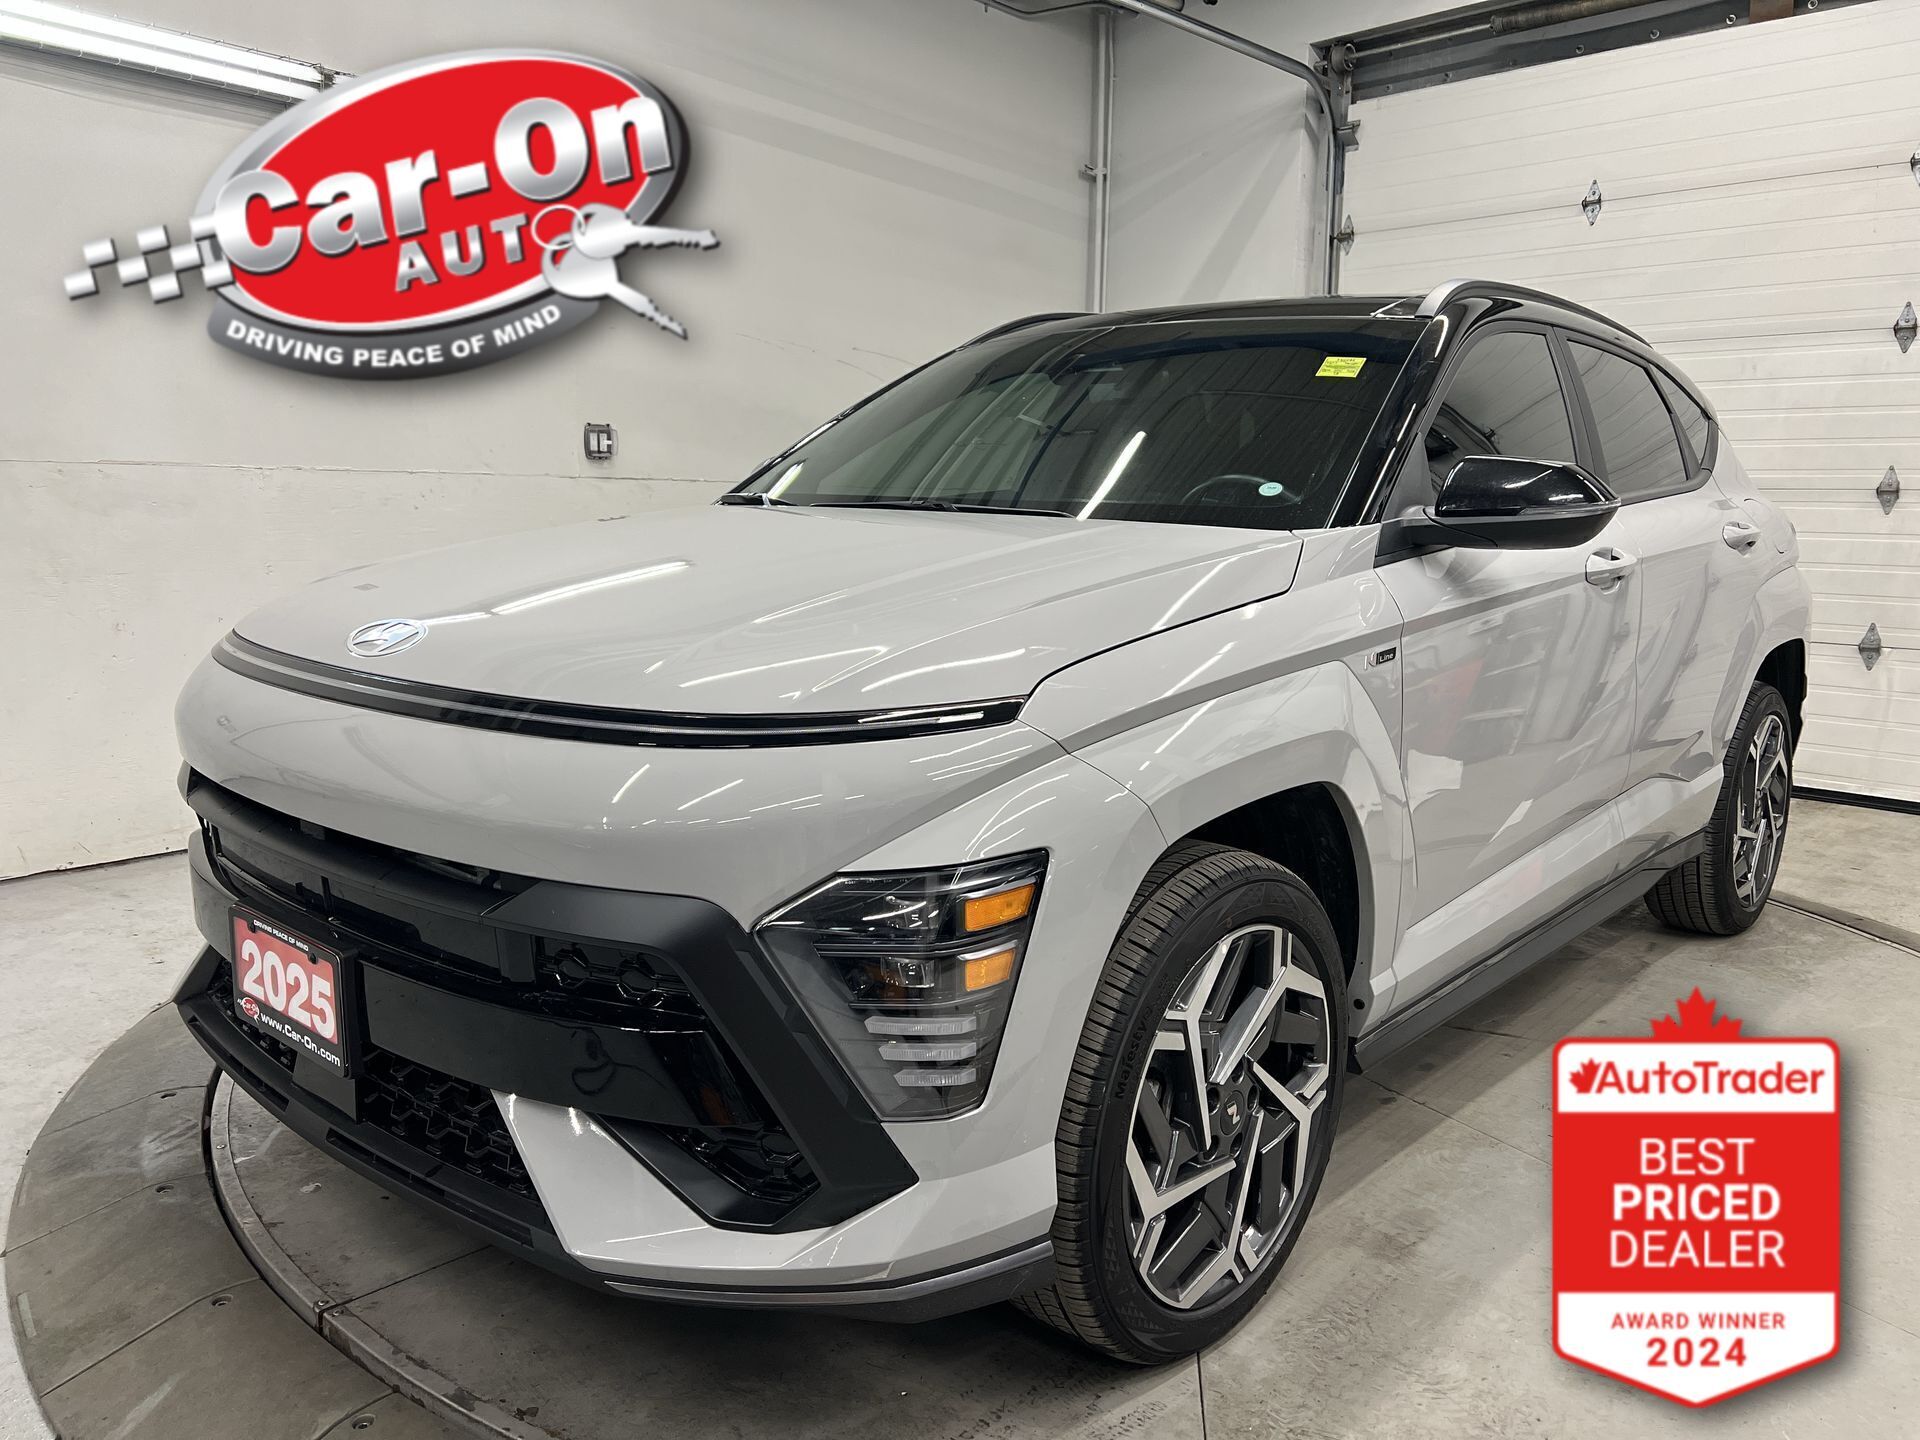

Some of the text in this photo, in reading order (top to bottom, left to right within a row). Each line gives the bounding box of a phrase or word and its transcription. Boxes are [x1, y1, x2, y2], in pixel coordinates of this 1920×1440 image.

[253, 919, 309, 952] DRIVING PEACE OF MIND
[241, 939, 335, 1039] 2025
[260, 1012, 341, 1067] www.Car-On.com
